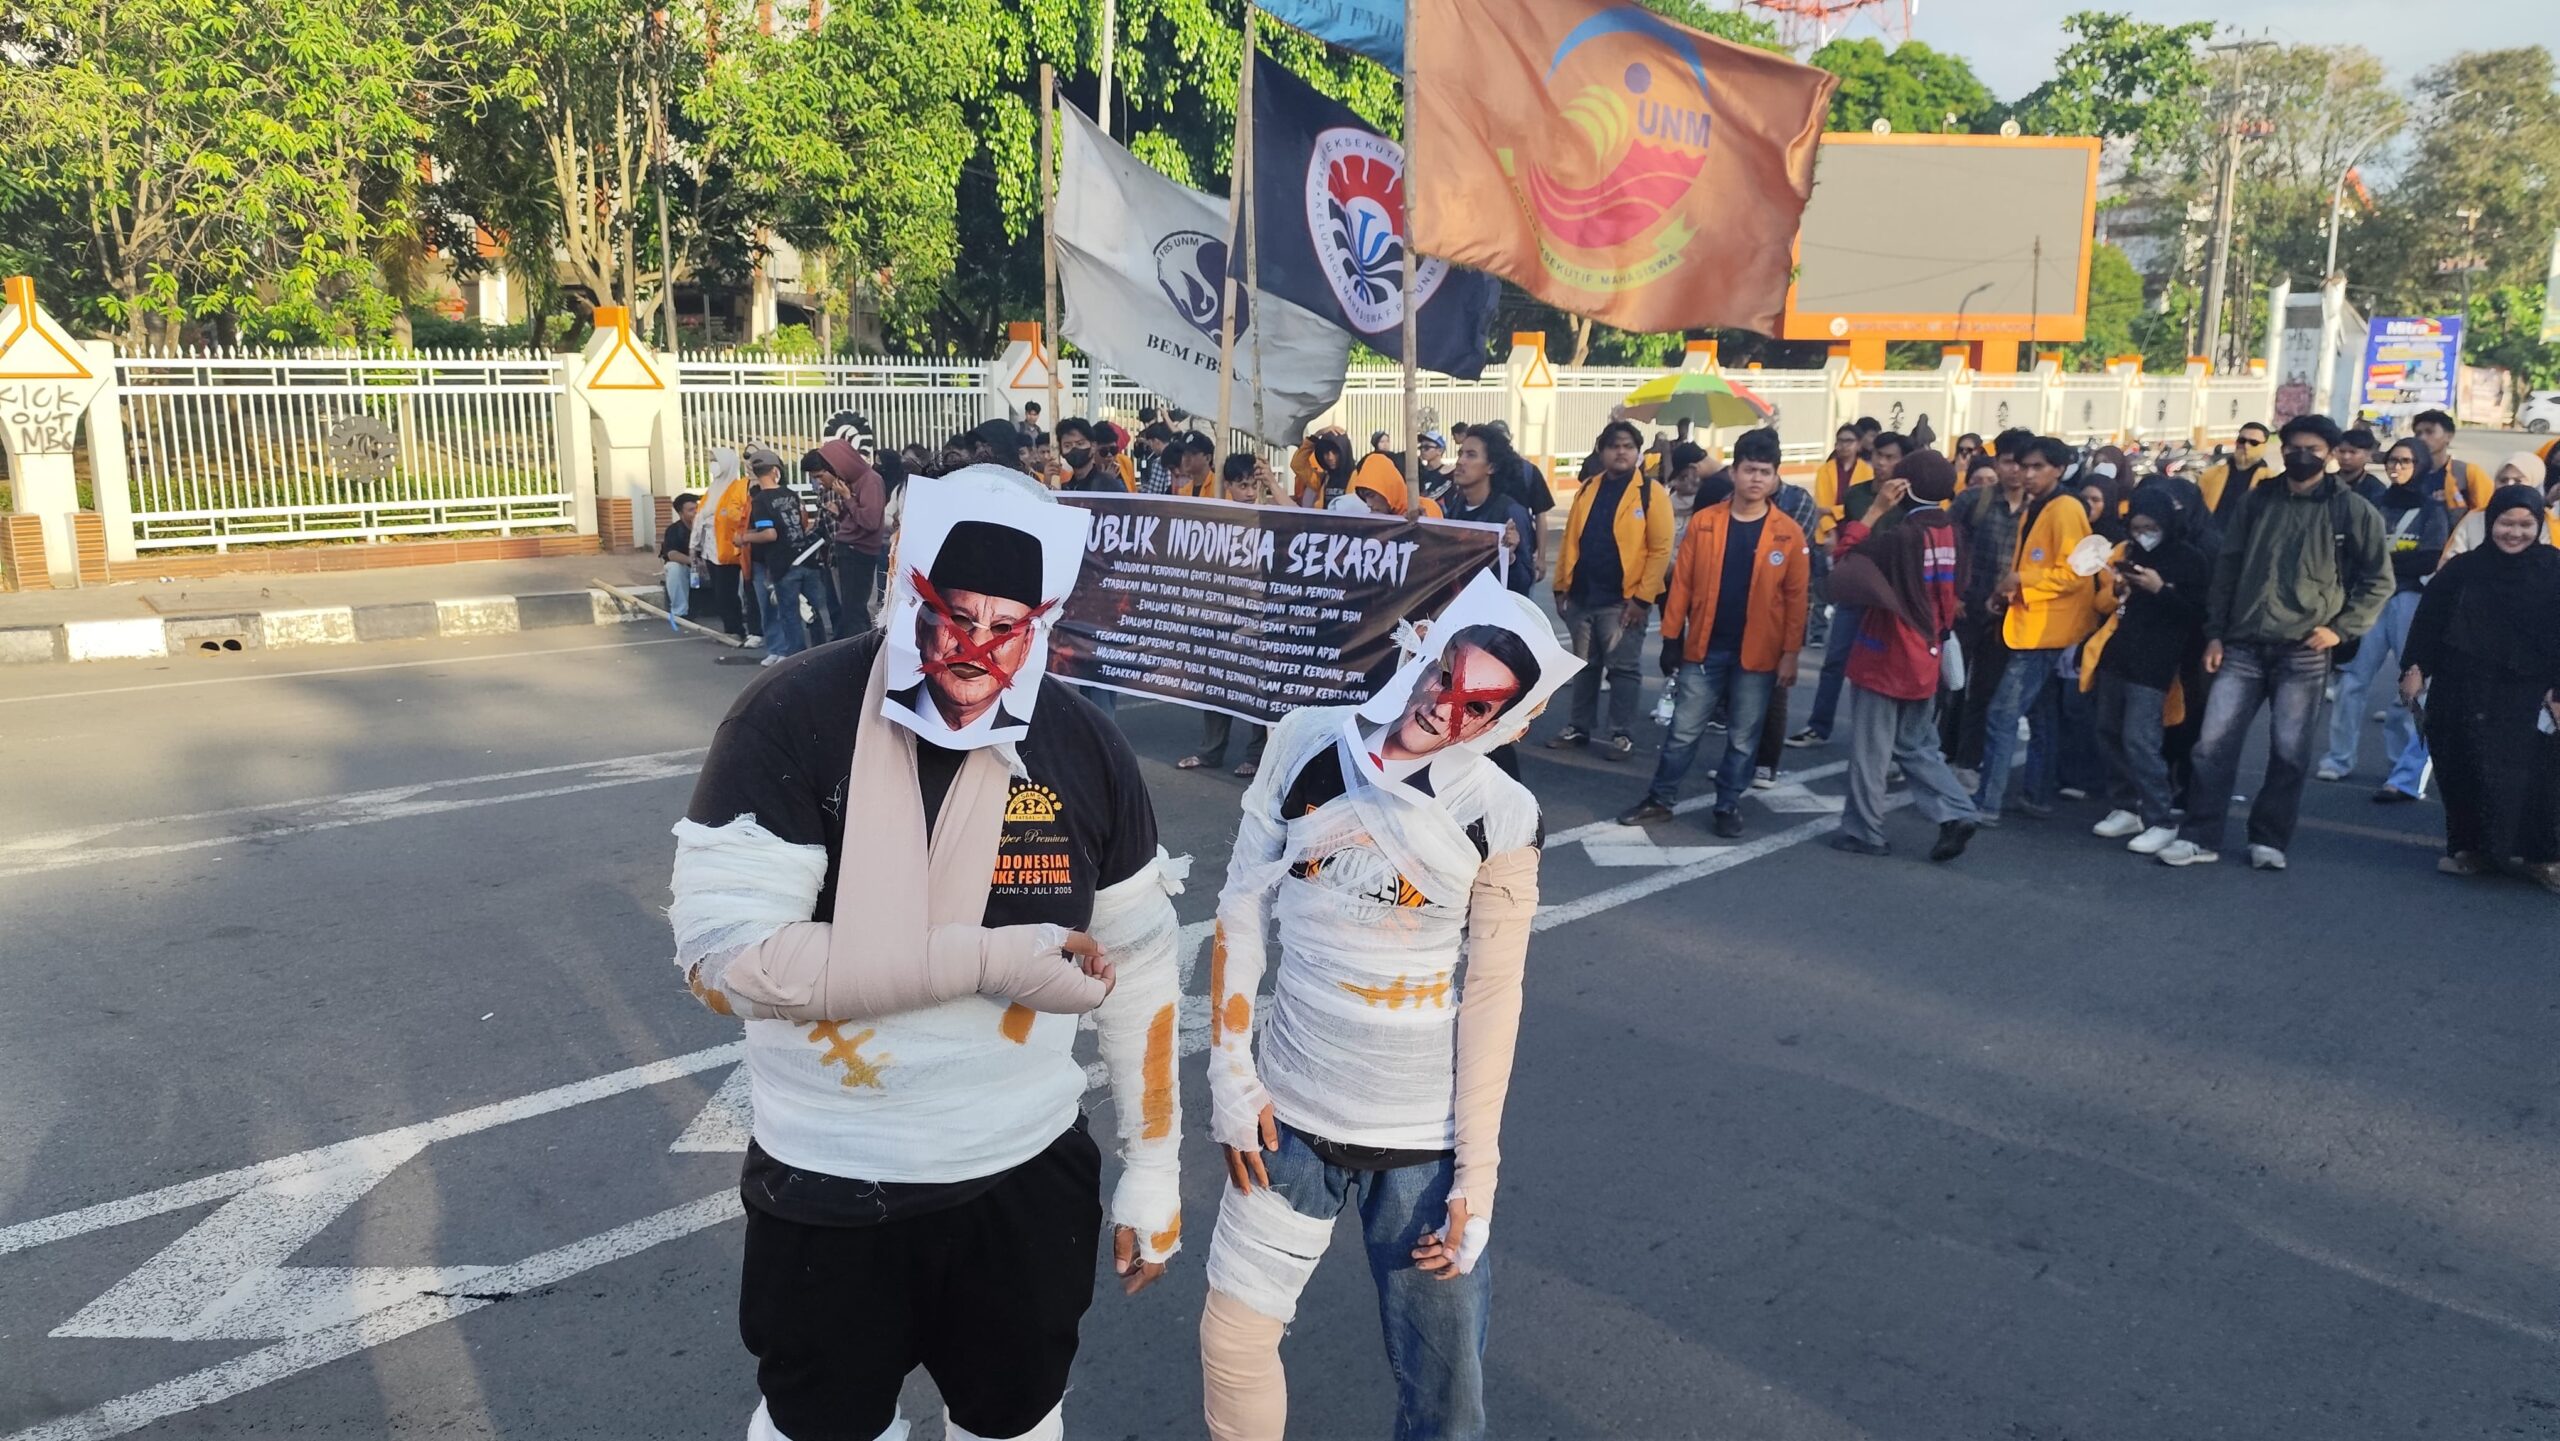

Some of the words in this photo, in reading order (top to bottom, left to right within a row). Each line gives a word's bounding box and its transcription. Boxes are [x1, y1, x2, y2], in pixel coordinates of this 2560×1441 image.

[1636, 99, 1712, 149] UNM
[1158, 242, 1174, 257] FBS
[1173, 236, 1200, 248] UNM
[1415, 265, 1438, 294] UNM
[1600, 252, 1678, 286] MAHASISWA
[1146, 334, 1191, 362] BEM
[0, 384, 81, 412] KICK
[11, 411, 74, 434] OUT
[1167, 517, 1275, 575] INDONESIA
[1285, 532, 1420, 587] SEKARAT
[1151, 565, 1189, 579] PENDIDIKAN
[1190, 569, 1212, 583] GRATIS
[1213, 573, 1226, 585] DAN
[1269, 582, 1303, 597] TENAGA
[1305, 586, 1347, 601] PENDIDIK
[1141, 580, 1159, 593] NILAI
[1159, 583, 1181, 597] TUKAR
[1182, 586, 1205, 599] RUPIAH
[1205, 590, 1225, 603] SERTA
[1226, 593, 1245, 607] HARGA
[1245, 597, 1286, 615] KEBUTUHAN
[1288, 604, 1318, 618] POKOK
[1320, 608, 1340, 621] DAN
[1342, 610, 1363, 624] BBM
[1170, 602, 1186, 616] MBG
[1186, 606, 1200, 618] DAN
[1201, 609, 1233, 625] HENTIKAN
[1259, 620, 1286, 634] MERAH
[1288, 623, 1317, 638] PUTIH
[1153, 619, 1190, 635] KEBIJAKAN
[1190, 625, 1215, 639] NEGARA
[1216, 630, 1230, 642] DAN
[1230, 632, 1259, 649] HENTIKAN
[1258, 639, 1315, 657] PEMBOROSAN
[1316, 646, 1342, 661] APBN
[1137, 635, 1176, 650] SUPREMASI
[1176, 641, 1191, 654] SIPIL
[1193, 644, 1207, 656] DAN
[1207, 647, 1239, 662] HENTIKAN
[1264, 659, 1301, 676] MILITER
[1302, 664, 1344, 682] KERUANG
[1345, 671, 1366, 684] SIPIL
[1142, 672, 1180, 688] SUPREMASI
[1181, 678, 1205, 693] HUKUM
[1205, 684, 1226, 699] SERTA
[1226, 689, 1255, 706] BERANTAS
[1255, 696, 1269, 709] KKN
[1269, 701, 1303, 713] SECA
[1183, 660, 1206, 675] PUBLIK
[1207, 666, 1225, 680] YANG
[1257, 678, 1281, 693] DALAM
[1282, 683, 1315, 697] SETIAP
[1315, 687, 1369, 701] KEBIJAKAN
[1015, 799, 1047, 815] 234
[1024, 829, 1069, 843] Premium
[996, 887, 1029, 895] JUNI-3
[1031, 887, 1052, 895] JULI
[1054, 886, 1073, 894] 2005
[1018, 869, 1072, 884] FESTIVAL
